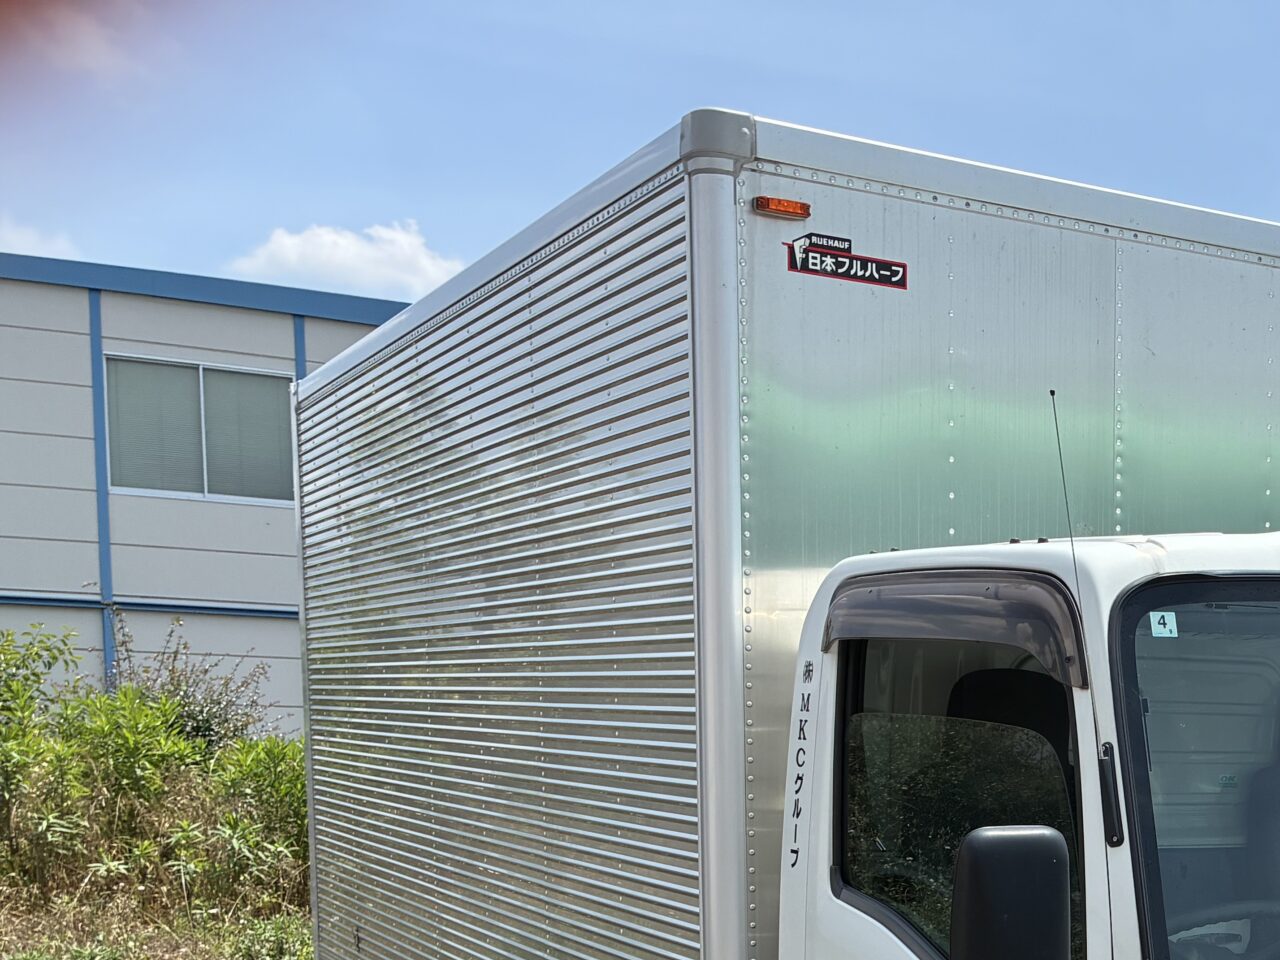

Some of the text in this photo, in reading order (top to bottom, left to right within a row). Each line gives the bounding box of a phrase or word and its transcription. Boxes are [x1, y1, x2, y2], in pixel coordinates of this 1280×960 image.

[808, 252, 903, 281] 日本フルハーフ
[1158, 614, 1167, 629] 4
